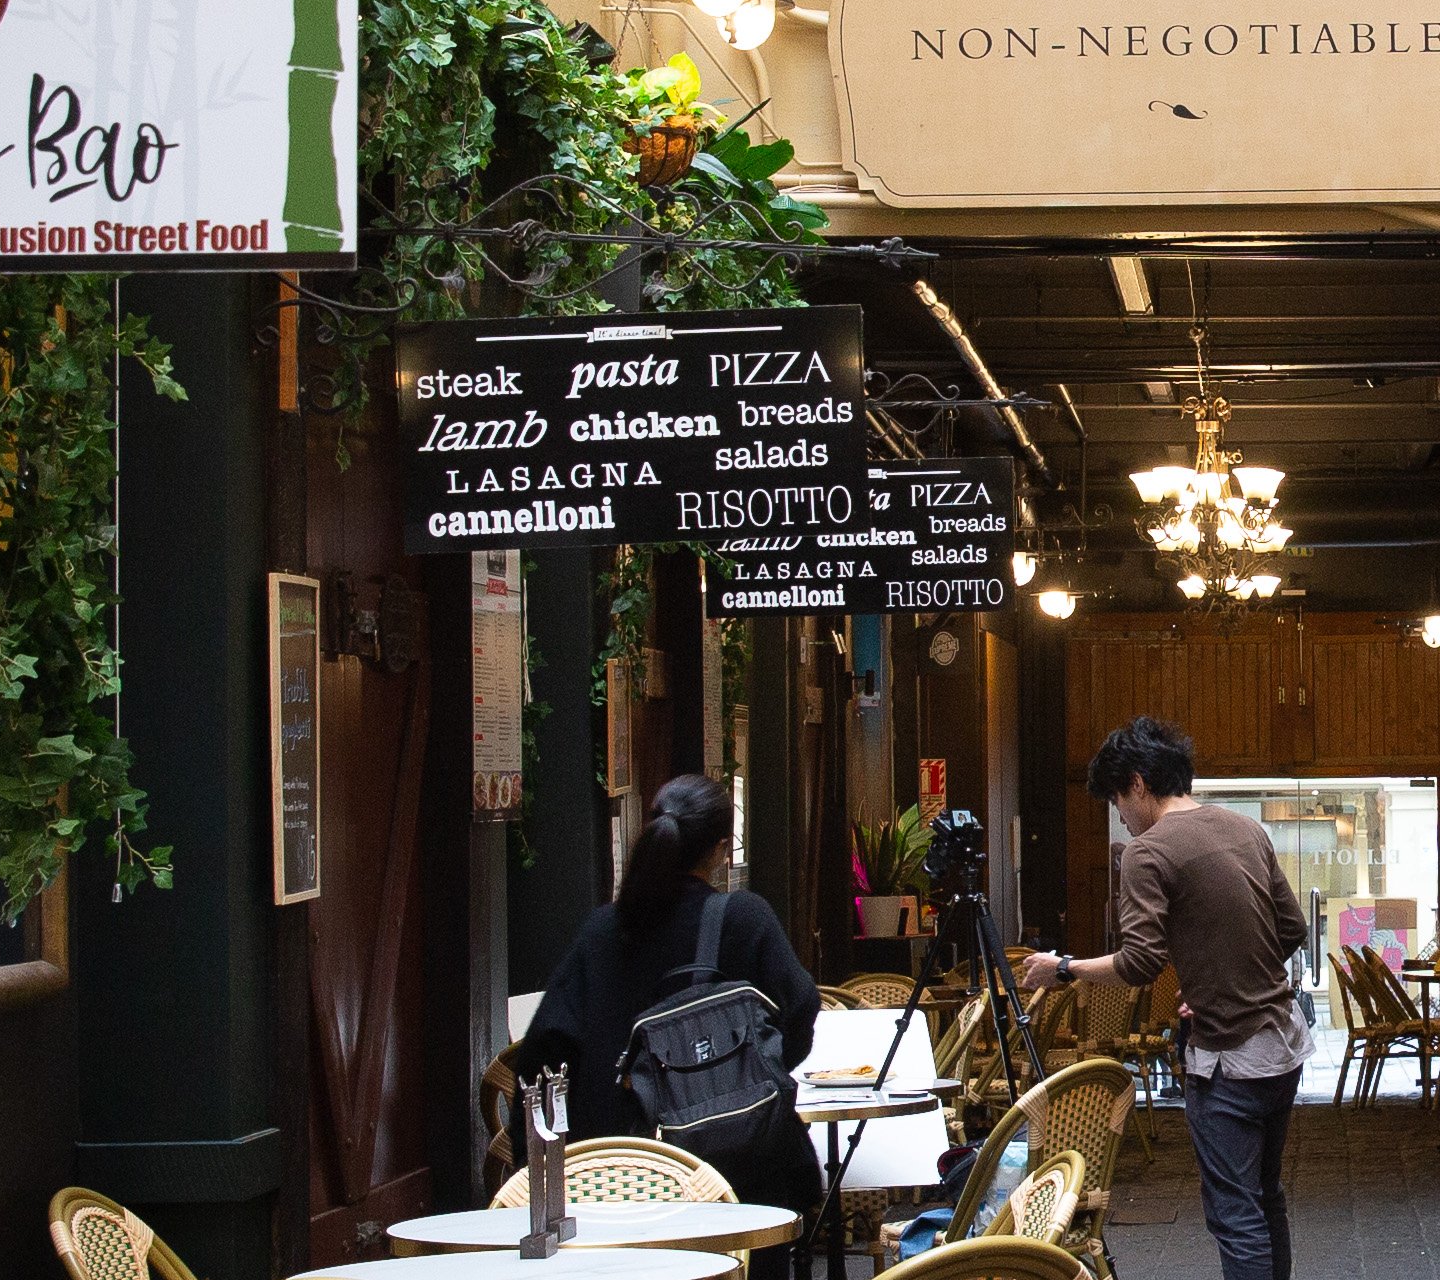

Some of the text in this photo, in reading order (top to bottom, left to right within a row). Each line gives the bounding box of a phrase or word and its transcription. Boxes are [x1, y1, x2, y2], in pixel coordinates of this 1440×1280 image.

[26, 74, 178, 204] Bao
[93, 220, 189, 252] Street
[196, 219, 268, 251] Food
[417, 350, 831, 399] steak pasta PIZZA
[418, 398, 853, 452] lamb chicken breads
[715, 438, 829, 471] salads
[446, 461, 661, 495] LASAGNA
[428, 497, 616, 537] cannelloni
[677, 484, 853, 531] RISOTTO
[911, 483, 992, 507] PIZZA
[817, 527, 917, 549] chicken
[929, 514, 1006, 534] breads
[734, 560, 877, 581] LASAGNA
[911, 544, 988, 567] salads
[722, 578, 1004, 609] cannelloni RISOTTO
